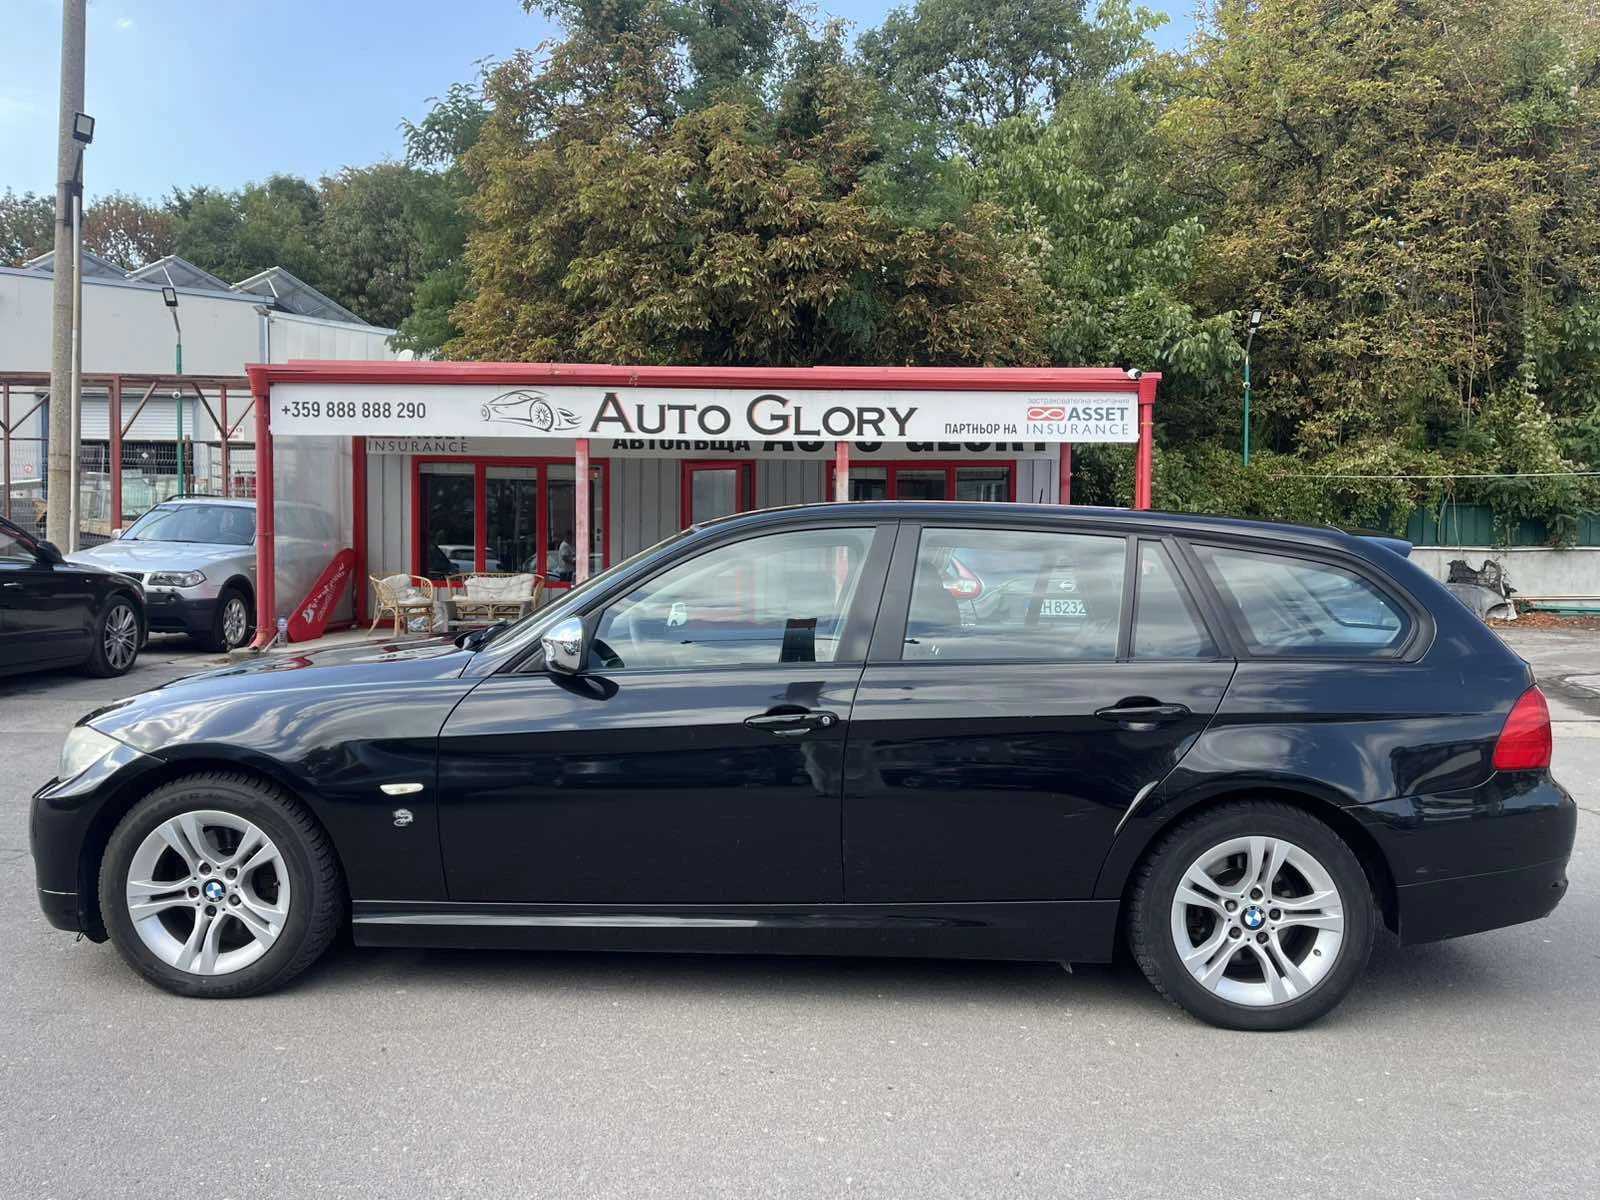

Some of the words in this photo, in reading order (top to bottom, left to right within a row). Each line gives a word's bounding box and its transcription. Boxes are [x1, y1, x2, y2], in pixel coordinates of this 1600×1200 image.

[281, 401, 320, 418] +359
[326, 401, 356, 418] 888
[362, 402, 391, 418] 888
[397, 402, 426, 418] 290
[1067, 407, 1129, 421] ASSET
[944, 423, 1001, 434] ПАРТНЬОР
[1003, 423, 1018, 434] НА
[1026, 423, 1129, 435] INSURANCE
[367, 440, 469, 453] INSURANCE
